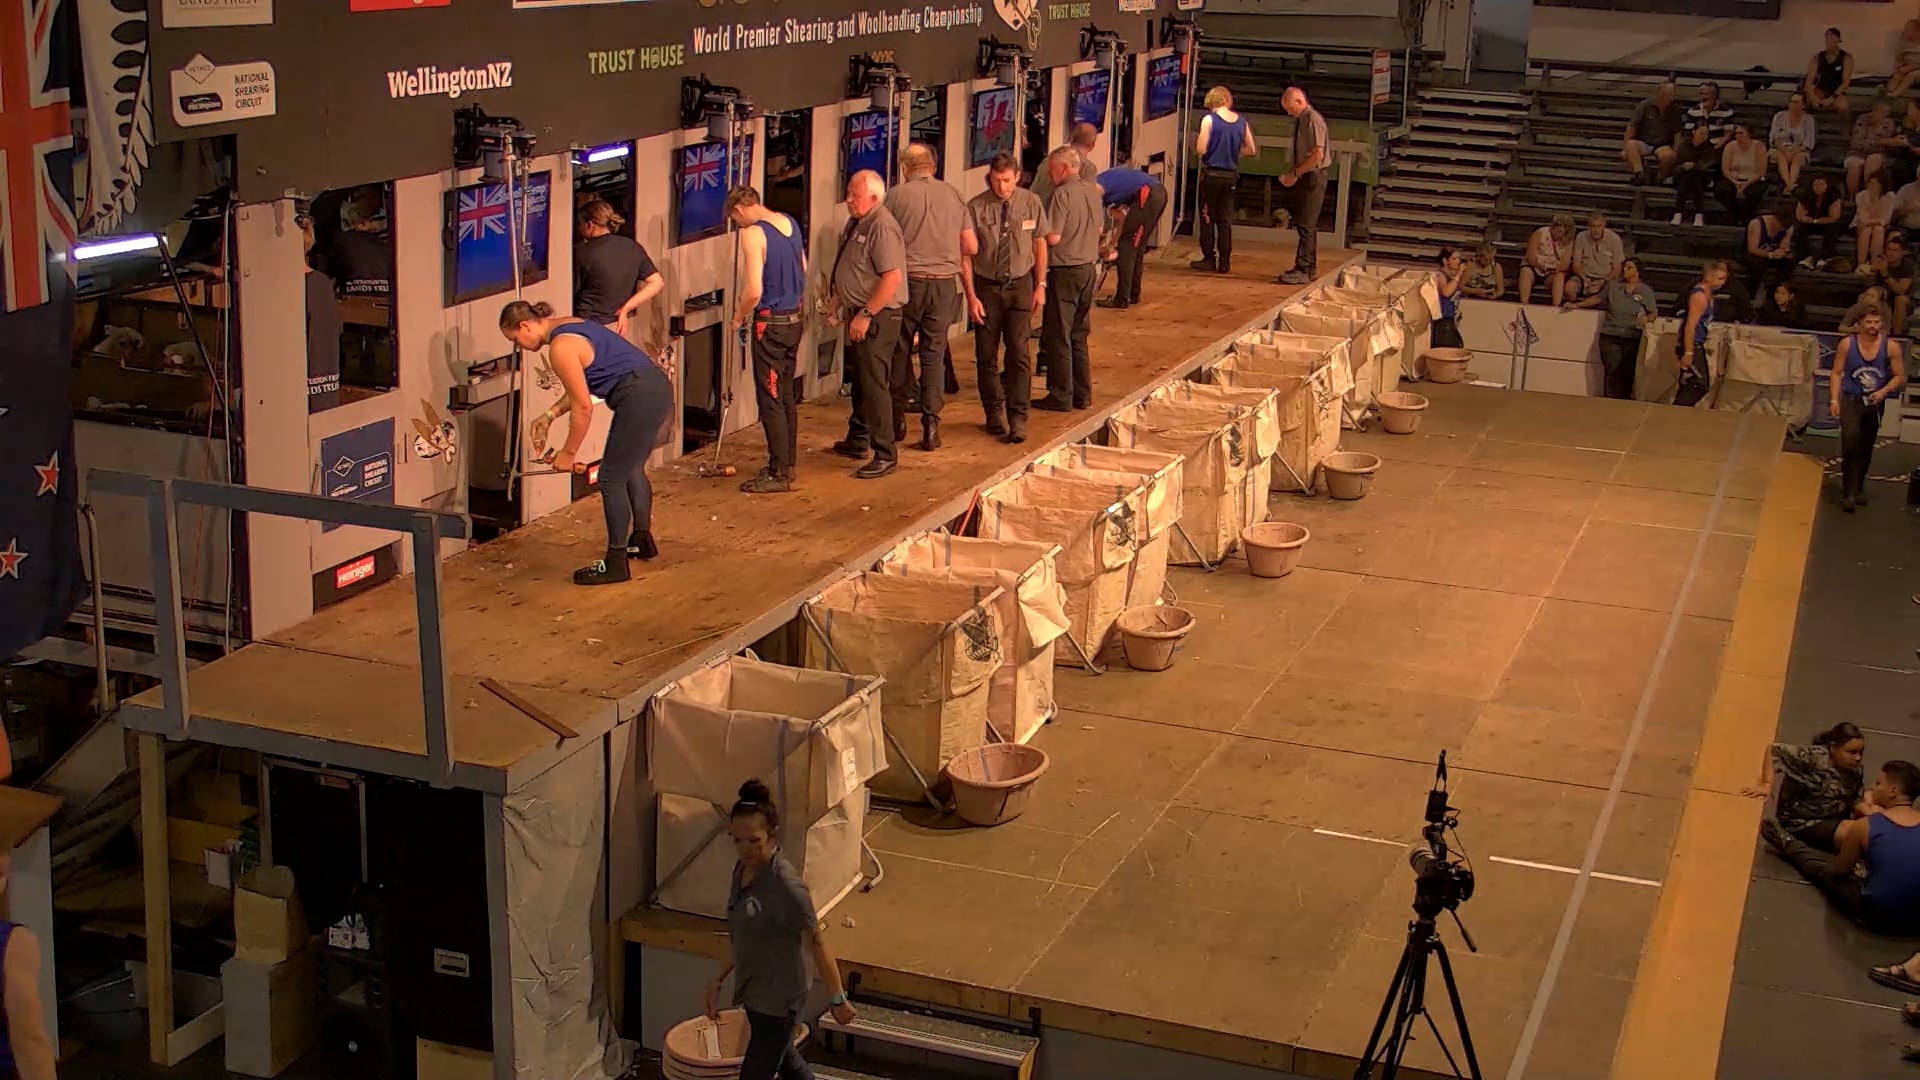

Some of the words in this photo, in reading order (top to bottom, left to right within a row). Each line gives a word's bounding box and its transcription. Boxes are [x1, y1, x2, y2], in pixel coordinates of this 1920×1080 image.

[1049, 5, 1068, 21] TRUST
[693, 24, 730, 54] World
[736, 22, 781, 50] Premier
[785, 17, 833, 44] Shearing
[837, 15, 856, 37] and
[858, 8, 921, 35] Woolhandling
[923, 3, 984, 31] Championship
[588, 50, 635, 75] TRUST
[640, 44, 684, 70] HOUSE
[234, 72, 270, 85] NATIONAL
[387, 62, 512, 99] WellingtonNZ
[234, 84, 270, 97] SHEARING
[235, 97, 263, 109] CIRCUIT
